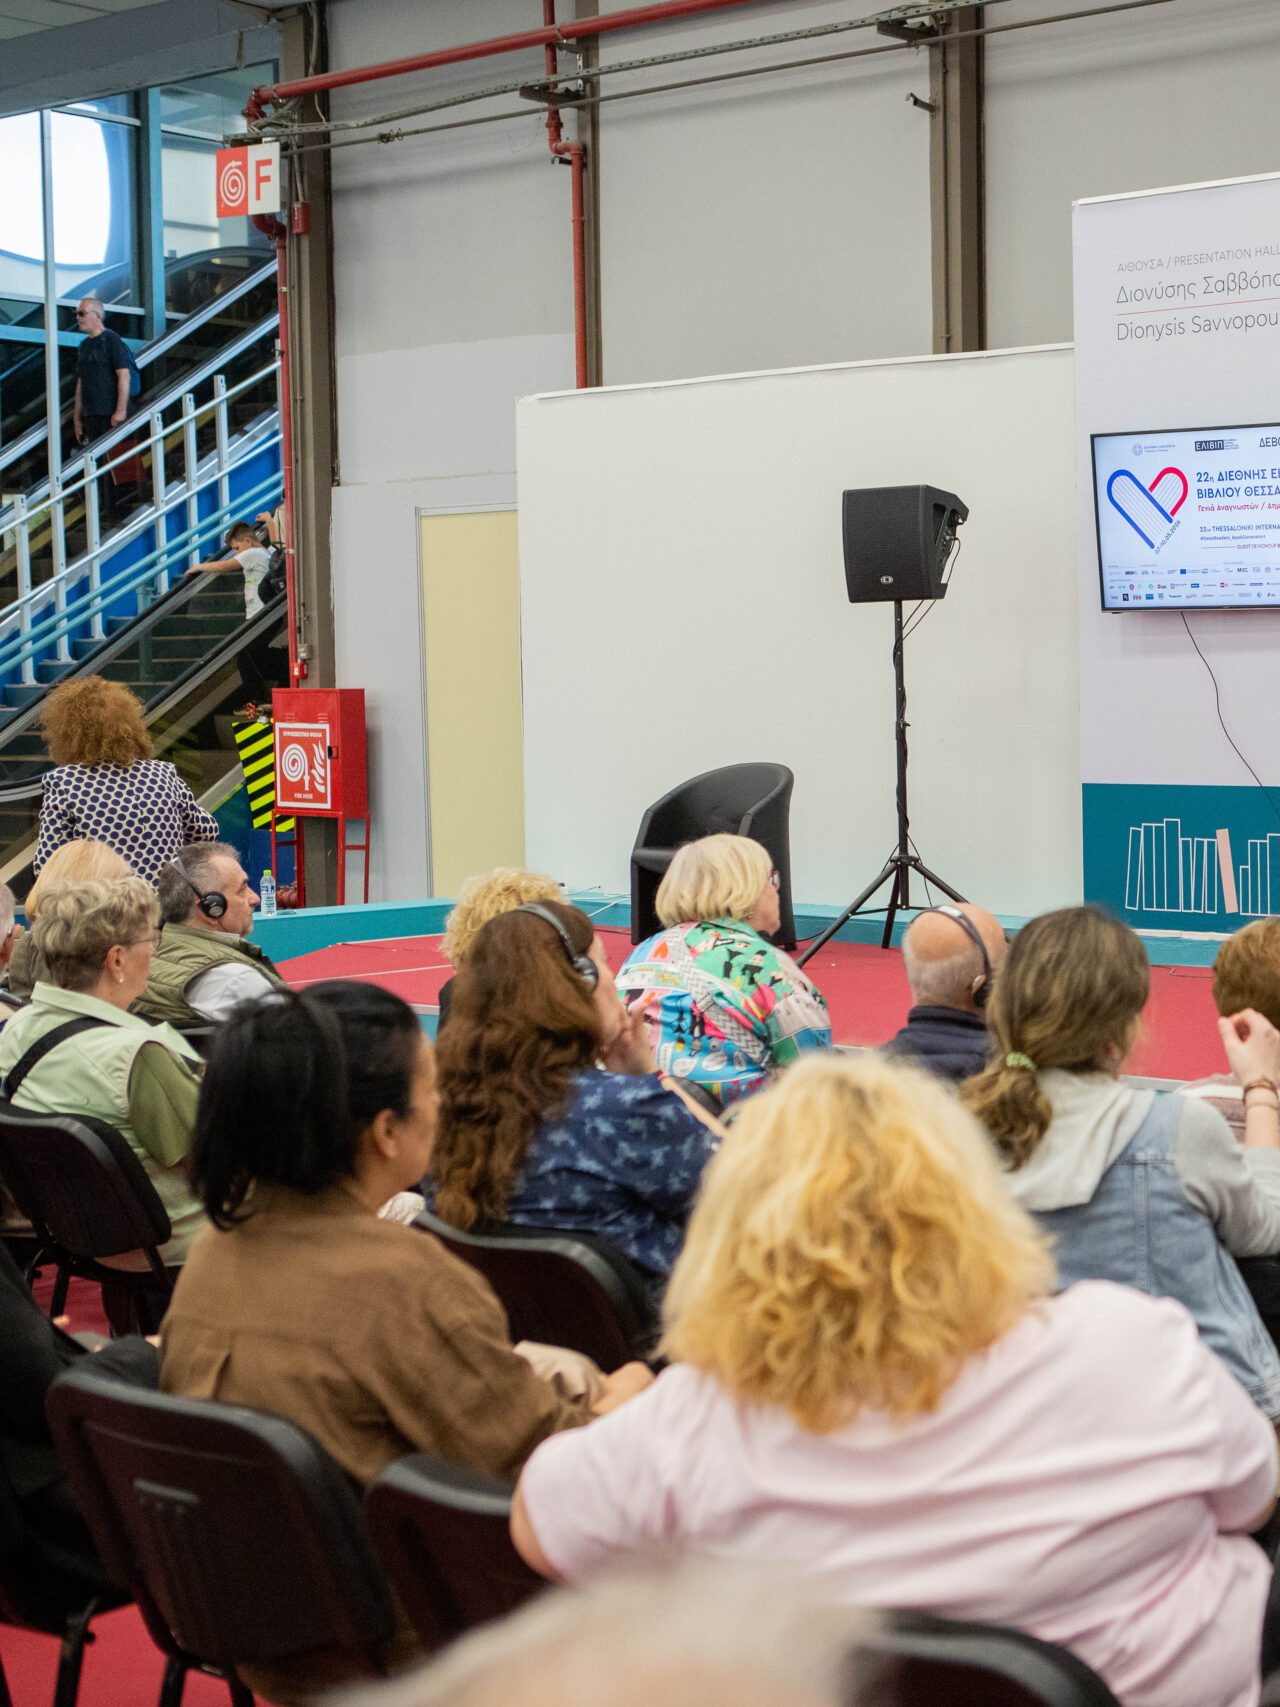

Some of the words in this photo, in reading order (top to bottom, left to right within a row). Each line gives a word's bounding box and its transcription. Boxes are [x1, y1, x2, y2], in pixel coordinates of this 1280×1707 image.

[255, 158, 273, 201] F
[1117, 258, 1164, 273] ΑΙΘΟΥΣΑ
[1173, 248, 1251, 267] PRESENTATION
[1116, 280, 1197, 304] Διονύσης
[1117, 317, 1186, 342] Dionysis
[1217, 469, 1267, 482] ΔΙΕΘΝΗΣ
[1197, 487, 1242, 499] ΒΙΒΛΙΟΥ
[1212, 524, 1254, 532] THESSALONIKI
